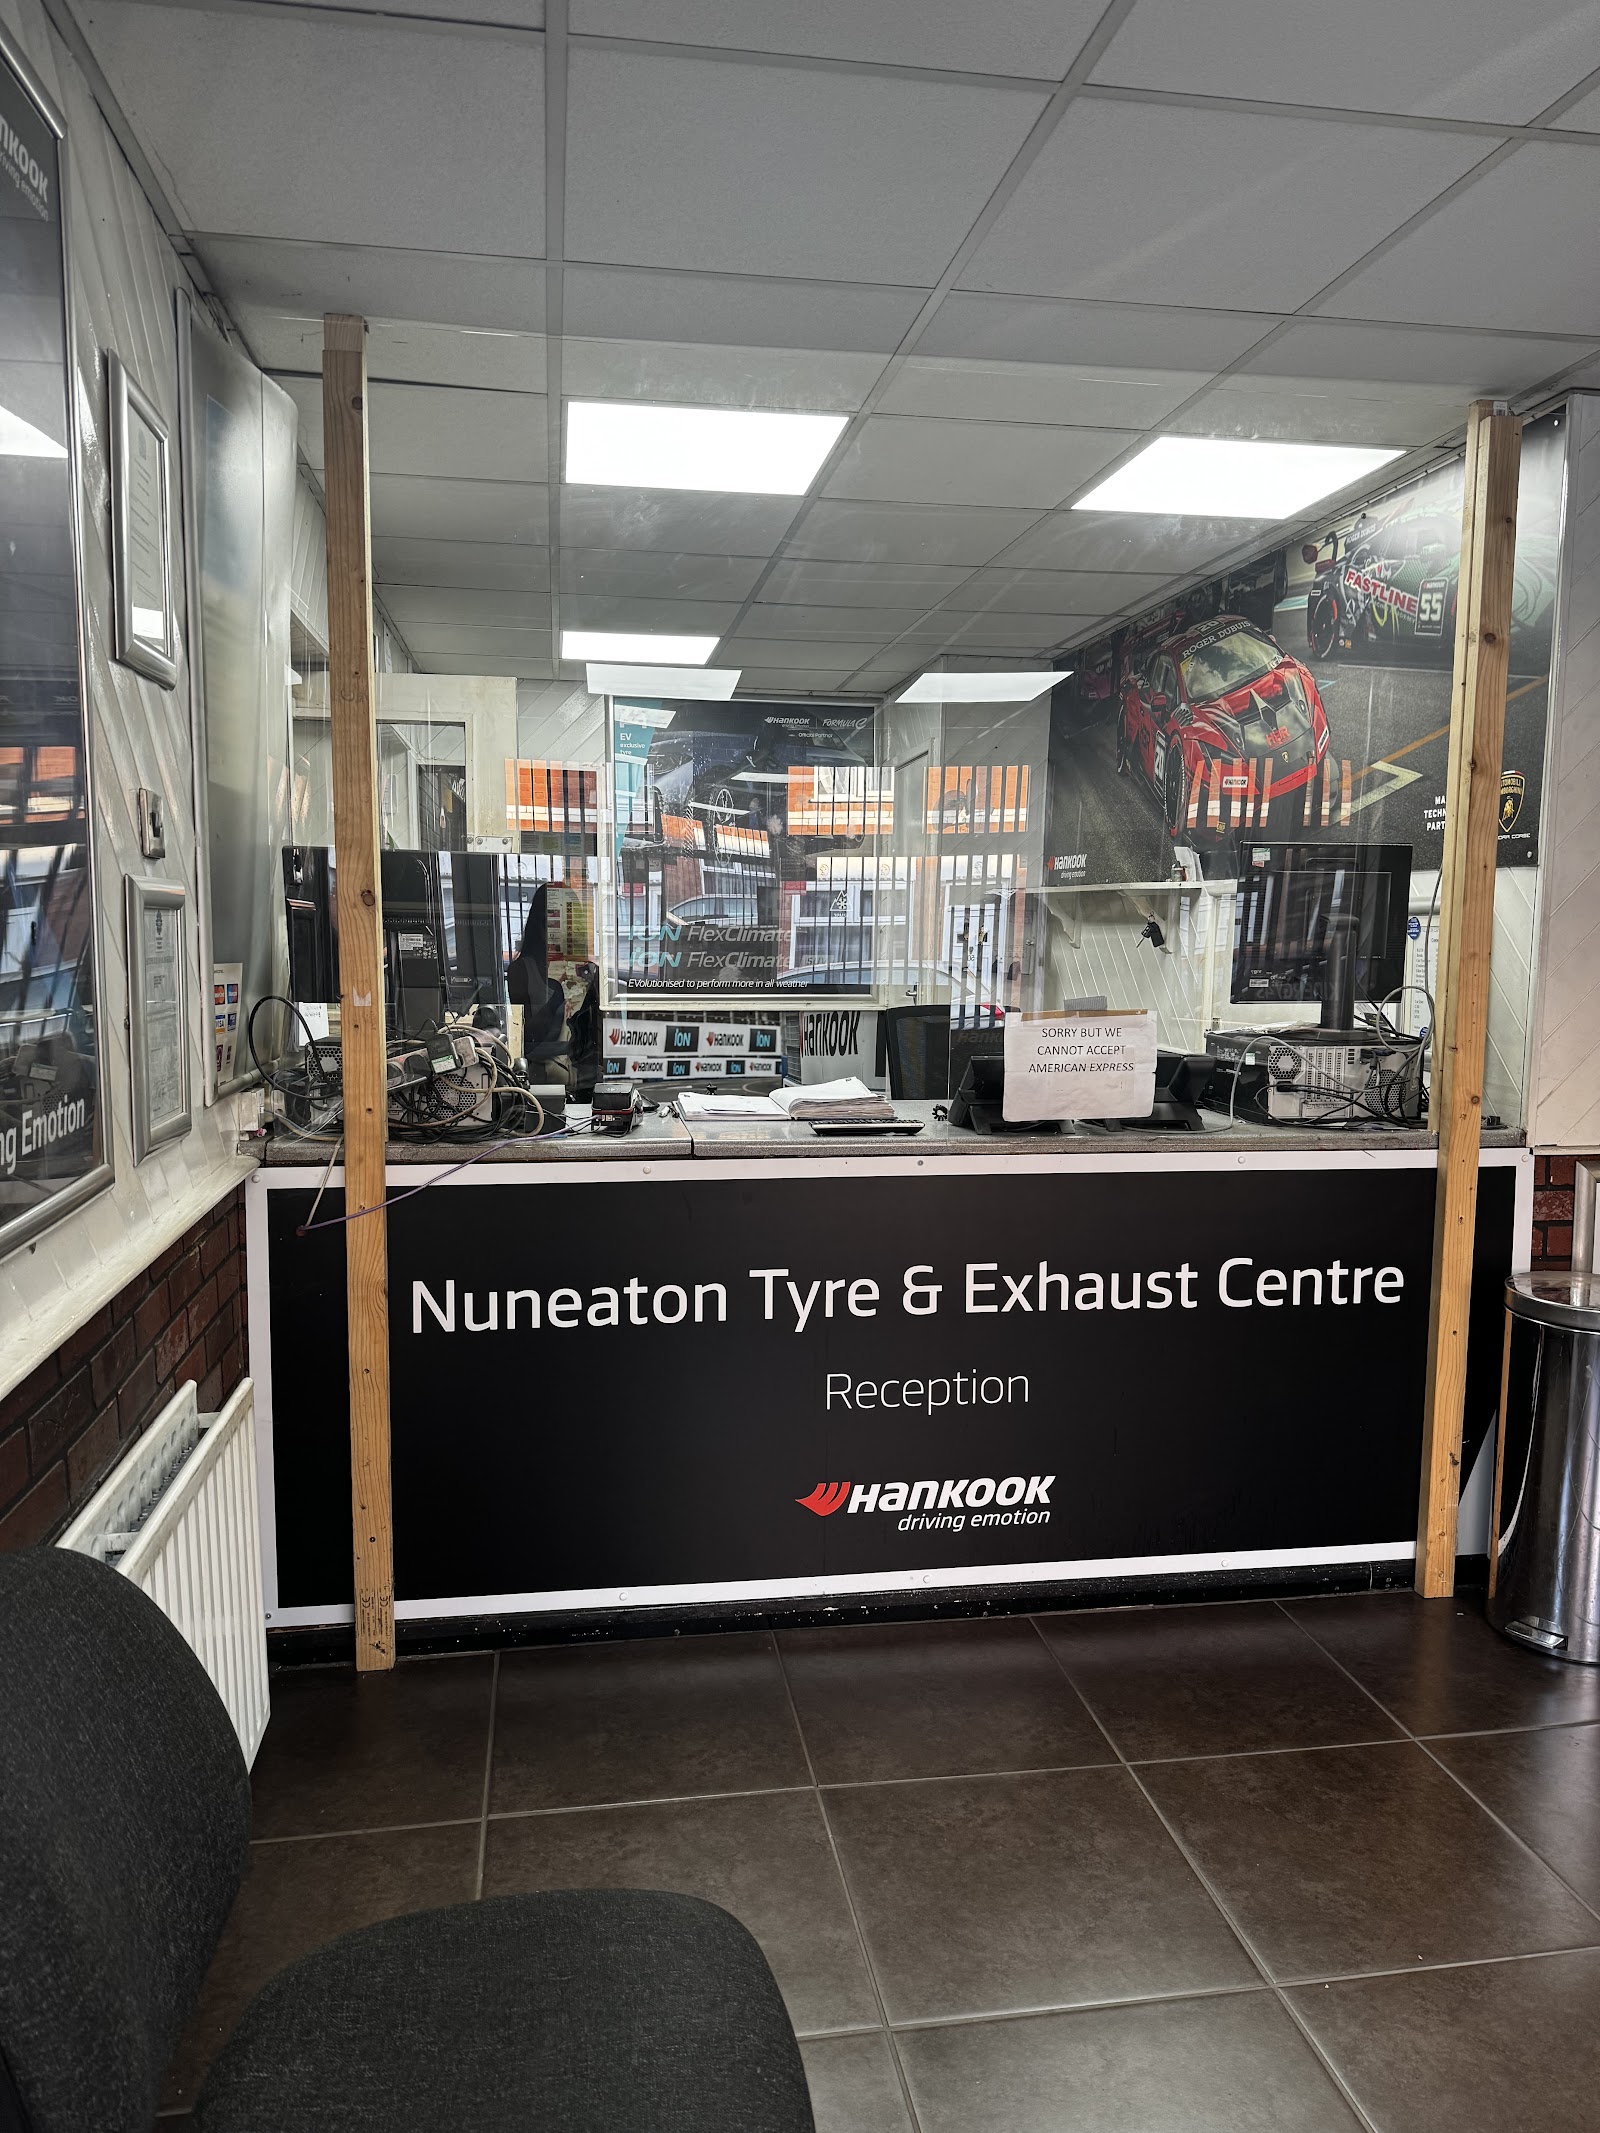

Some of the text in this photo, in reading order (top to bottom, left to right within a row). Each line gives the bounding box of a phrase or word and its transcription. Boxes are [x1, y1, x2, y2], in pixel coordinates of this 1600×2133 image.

[1345, 569, 1419, 616] FASTLINE
[1420, 593, 1443, 621] 55
[1181, 621, 1251, 658] ROGER DUBUIS
[822, 719, 855, 727] FORMULA
[620, 733, 632, 741] EV
[1427, 822, 1446, 831] PART
[687, 926, 791, 942] FlexClimate
[687, 952, 790, 968] FlexClimate
[628, 979, 685, 988] EVolutionised
[686, 979, 696, 988] to
[696, 978, 731, 990] perform
[756, 979, 764, 988] in
[765, 978, 774, 988] all
[775, 979, 810, 988] weather
[1041, 1027, 1122, 1038] SORRY BUT WE
[1037, 1045, 1127, 1056] CANNOT ACCEPT
[1028, 1062, 1135, 1073] AMERICAN EXPRESS
[22, 1094, 85, 1156] Emotion
[412, 1257, 1405, 1334] Nuneaton Tyre & Exhaust Centre
[825, 1368, 1030, 1416] Reception
[847, 1474, 1056, 1514] HANKOOK
[897, 1507, 1051, 1533] driving emotion
